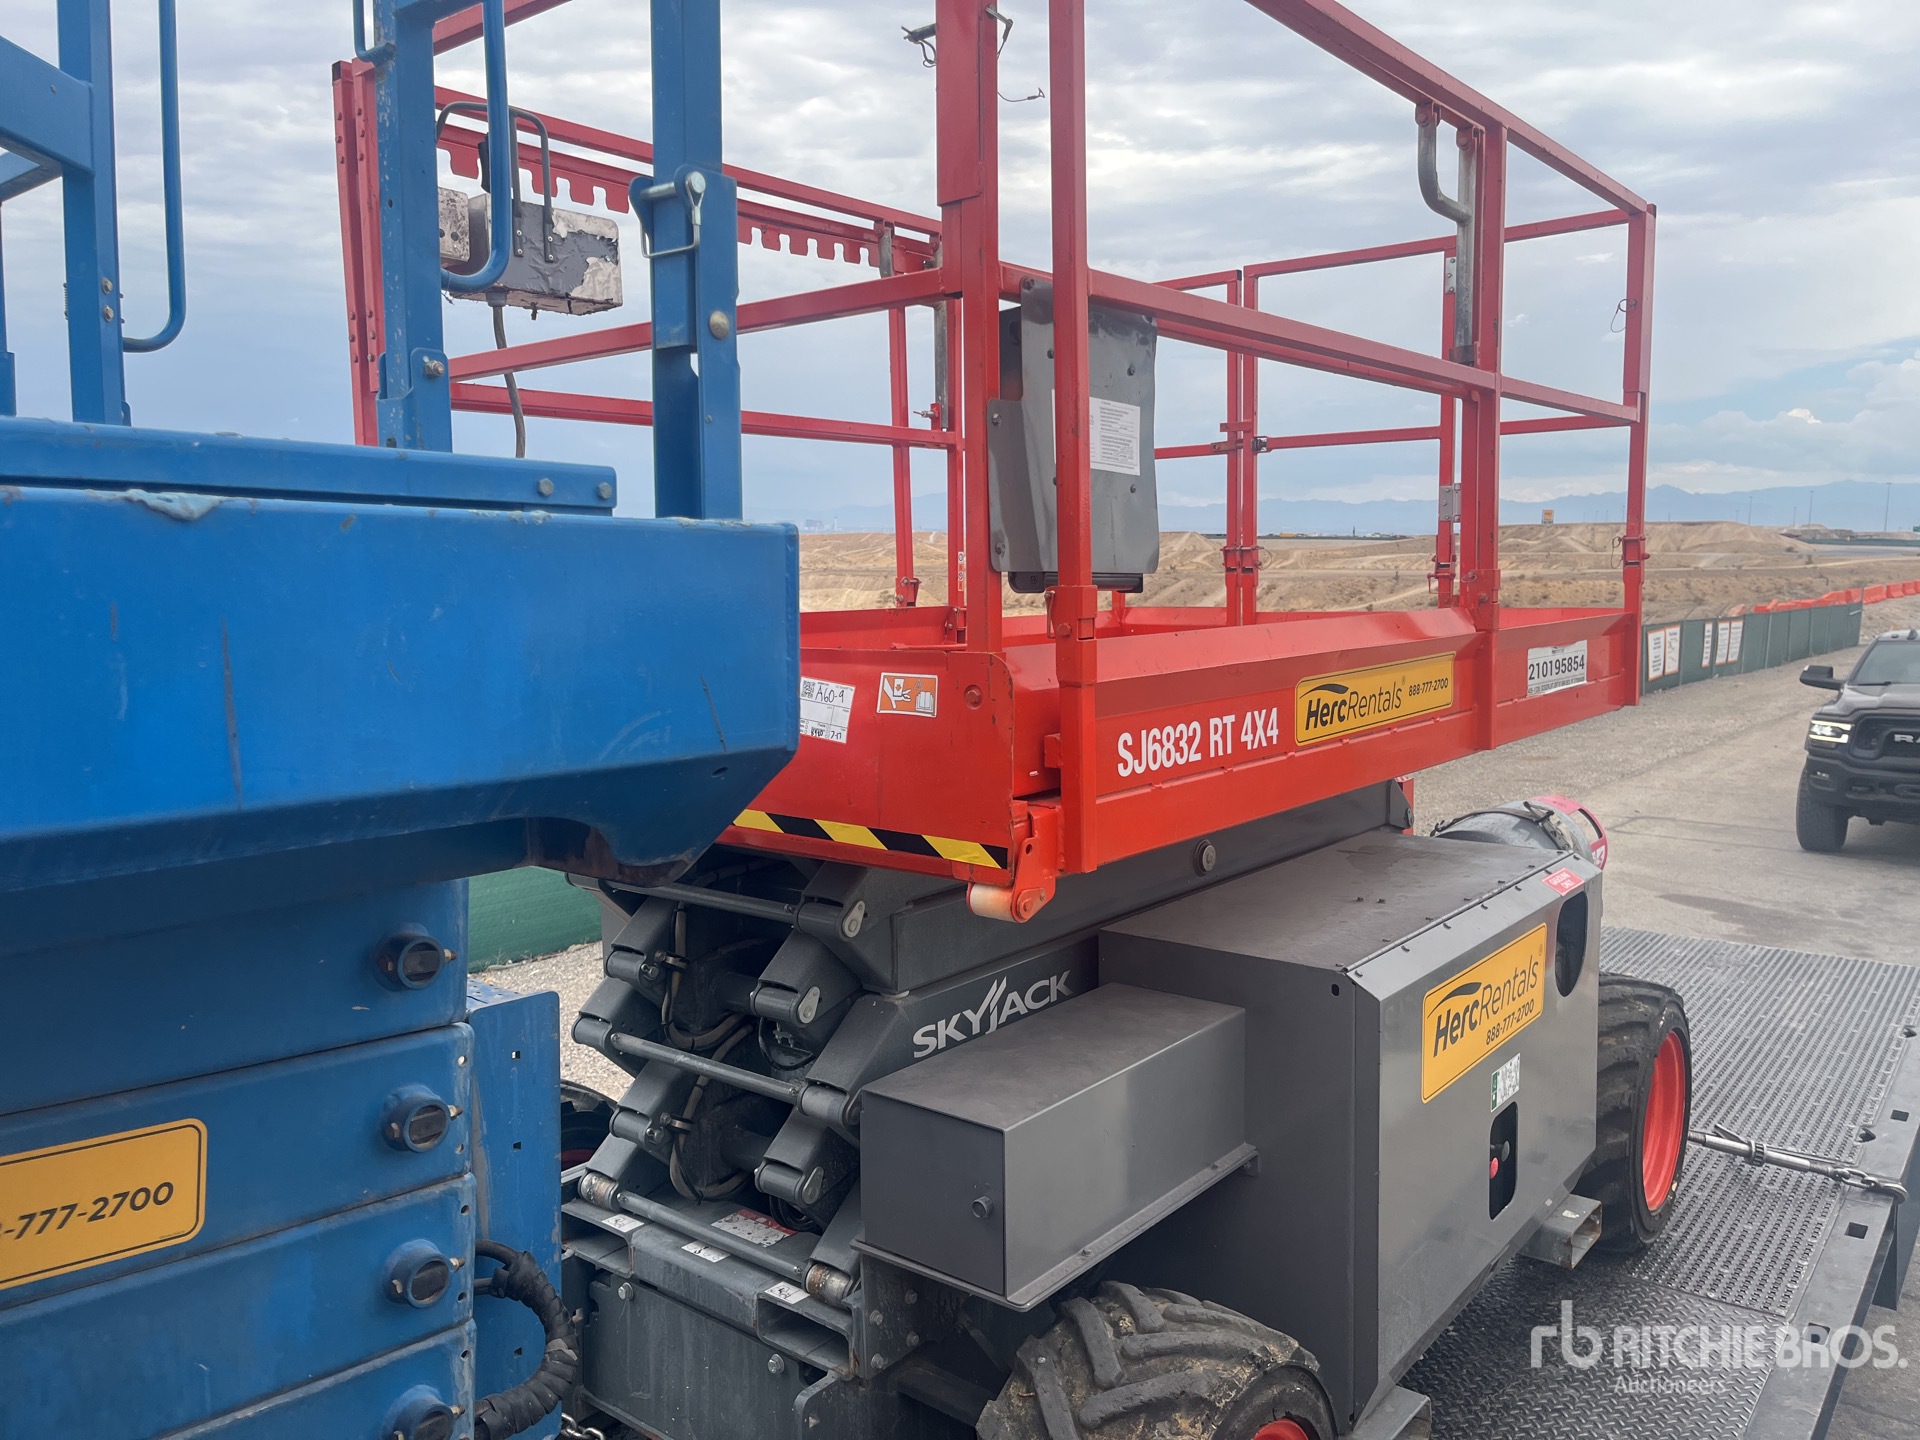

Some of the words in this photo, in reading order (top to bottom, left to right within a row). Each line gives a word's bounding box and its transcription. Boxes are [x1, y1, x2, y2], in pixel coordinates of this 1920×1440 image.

[1528, 654, 1585, 681] 210195854
[1304, 681, 1402, 731] HercRentals
[1408, 677, 1449, 697] 888-777-2700
[1117, 721, 1202, 777] SJ6832
[1209, 714, 1236, 758] RT
[1240, 707, 1279, 751] 4X4
[912, 970, 1074, 1059] SKYJACK
[1433, 955, 1539, 1058] HercRentals
[1485, 998, 1535, 1046] 888-777-2700
[0, 1181, 174, 1241] -777-2700
